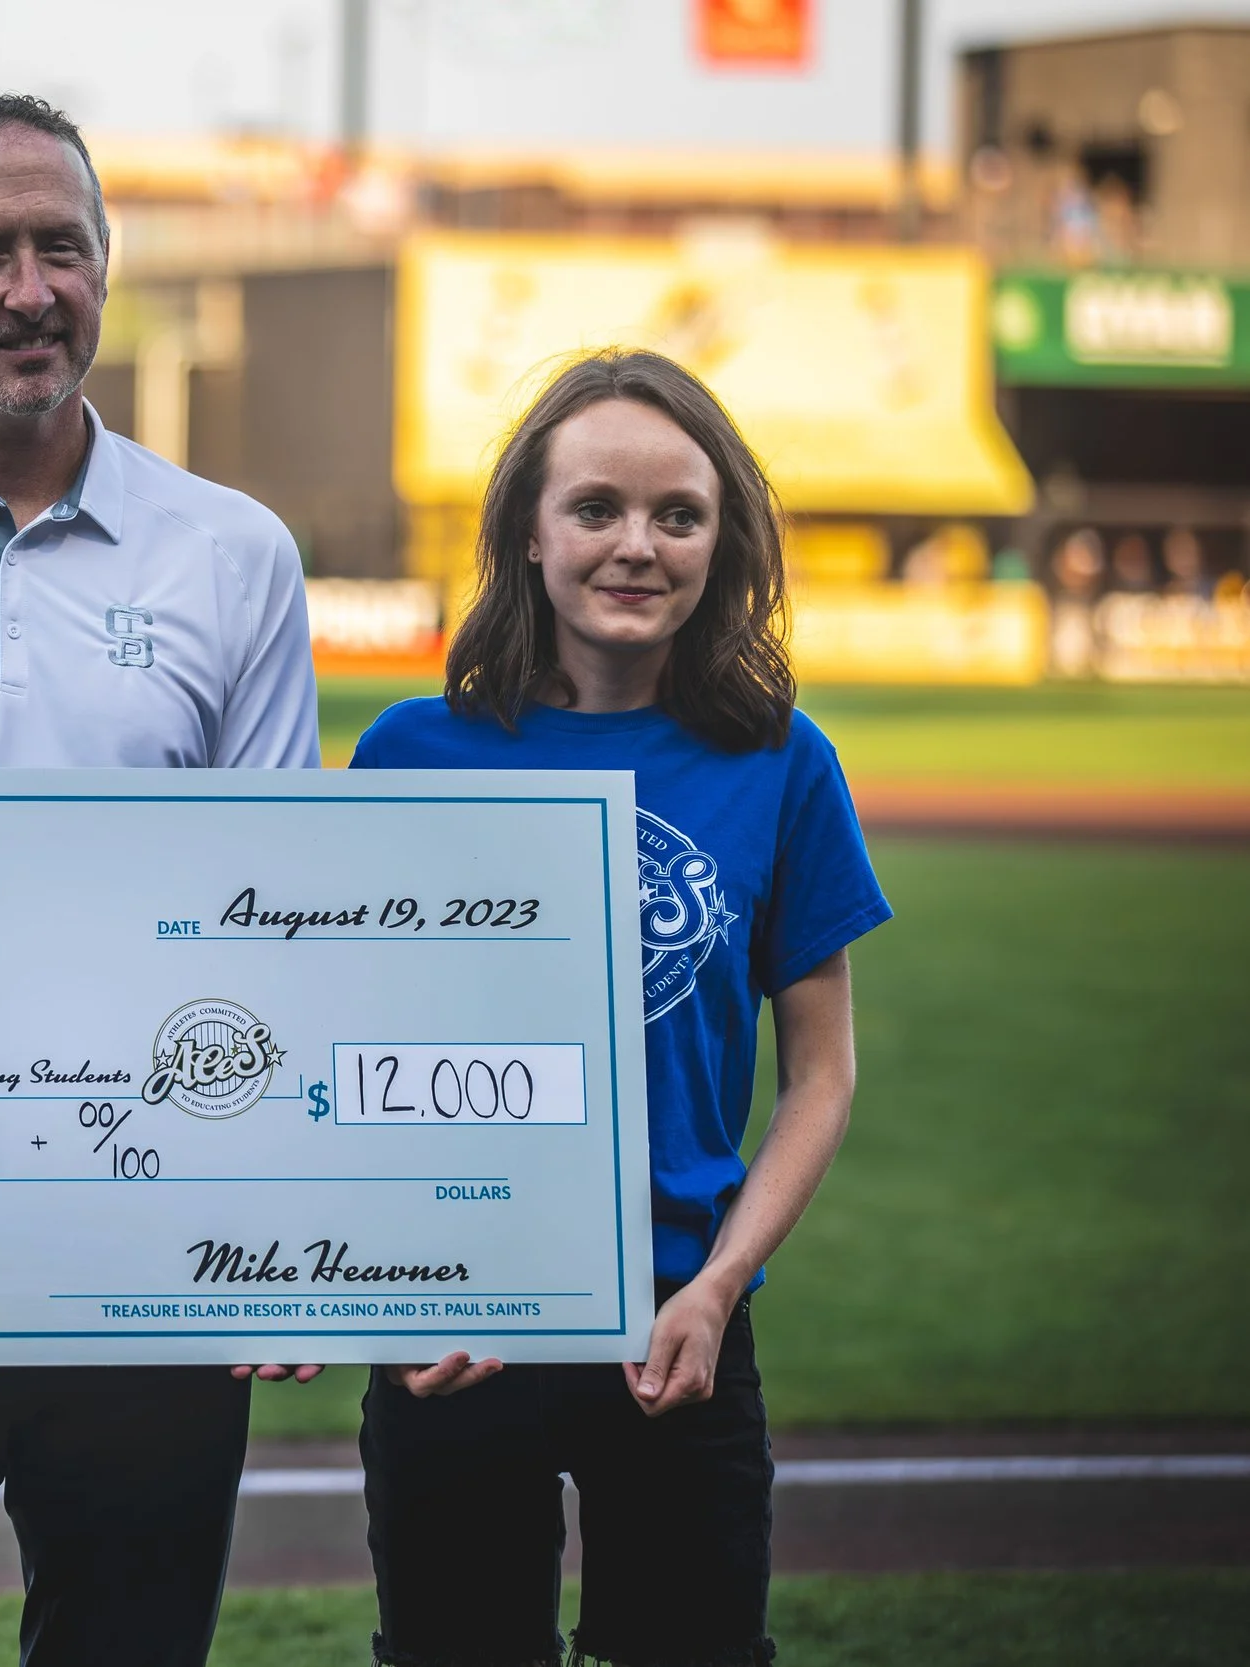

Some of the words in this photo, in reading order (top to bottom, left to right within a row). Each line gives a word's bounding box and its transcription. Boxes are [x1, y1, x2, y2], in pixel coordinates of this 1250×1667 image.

[157, 920, 201, 935] DATE
[220, 887, 370, 941] August
[379, 897, 426, 931] 19,
[440, 898, 540, 930] 2023
[167, 1011, 197, 1041] ATHLETES
[199, 1007, 247, 1025] COMMITTED
[30, 1059, 132, 1084] Students
[181, 1093, 189, 1103] TO
[190, 1100, 232, 1111] EDUCATING
[232, 1079, 260, 1106] STUDENTS
[308, 1081, 330, 1122] $
[435, 1185, 512, 1201] DOLLARS
[186, 1239, 299, 1283] Mike
[303, 1239, 469, 1283] Heavner
[101, 1304, 180, 1317] TREASURE
[184, 1304, 239, 1317] ISLAND
[244, 1304, 302, 1317] RESORT
[305, 1303, 317, 1316] &
[320, 1303, 378, 1316] CASINO
[382, 1303, 416, 1316] AND
[420, 1303, 441, 1316] ST.
[445, 1303, 483, 1316] PAUL
[486, 1303, 540, 1316] SAINTS
